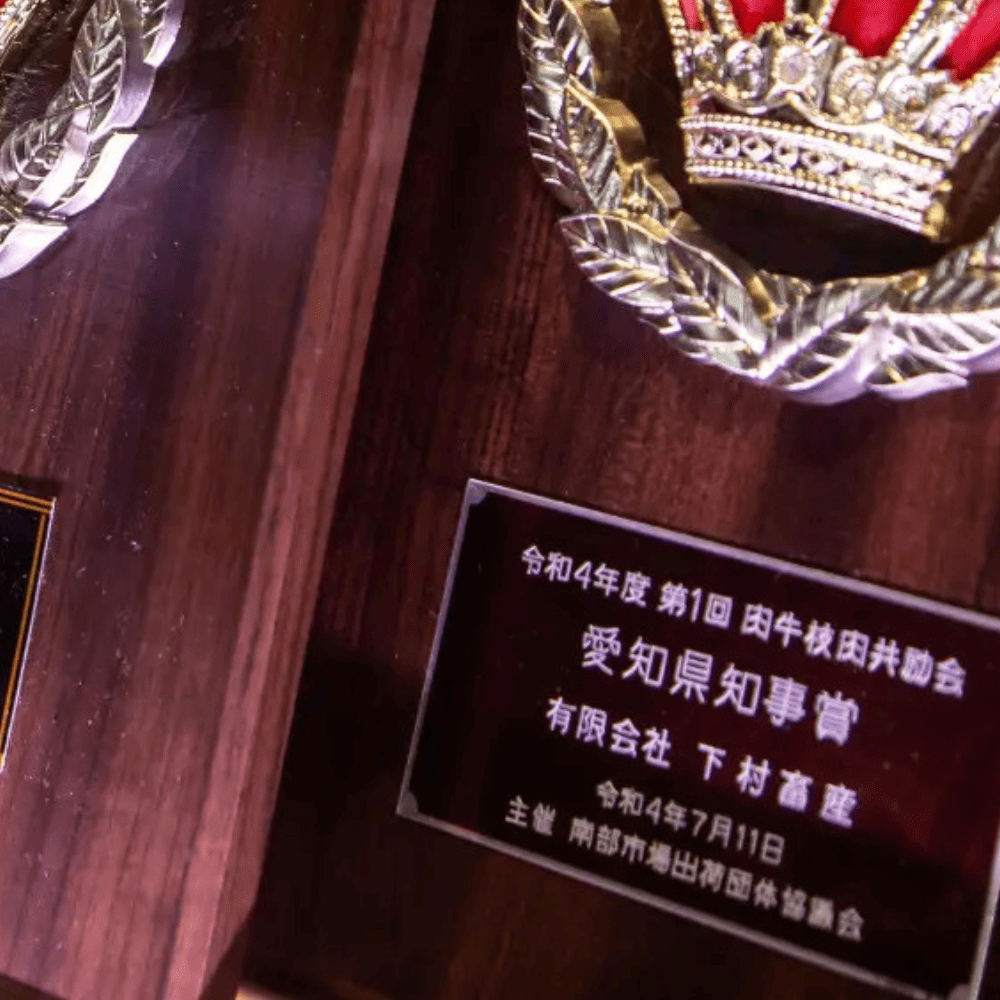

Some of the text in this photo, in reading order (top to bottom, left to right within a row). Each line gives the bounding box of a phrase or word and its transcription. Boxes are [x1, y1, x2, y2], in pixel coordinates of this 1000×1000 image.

[522, 546, 651, 606] 令和4年度
[658, 582, 732, 628] 第1回
[583, 625, 859, 745] 愛知県知事賞
[547, 697, 856, 826] 有限会社 下村畜産
[598, 781, 784, 864] 令和4年7月11日
